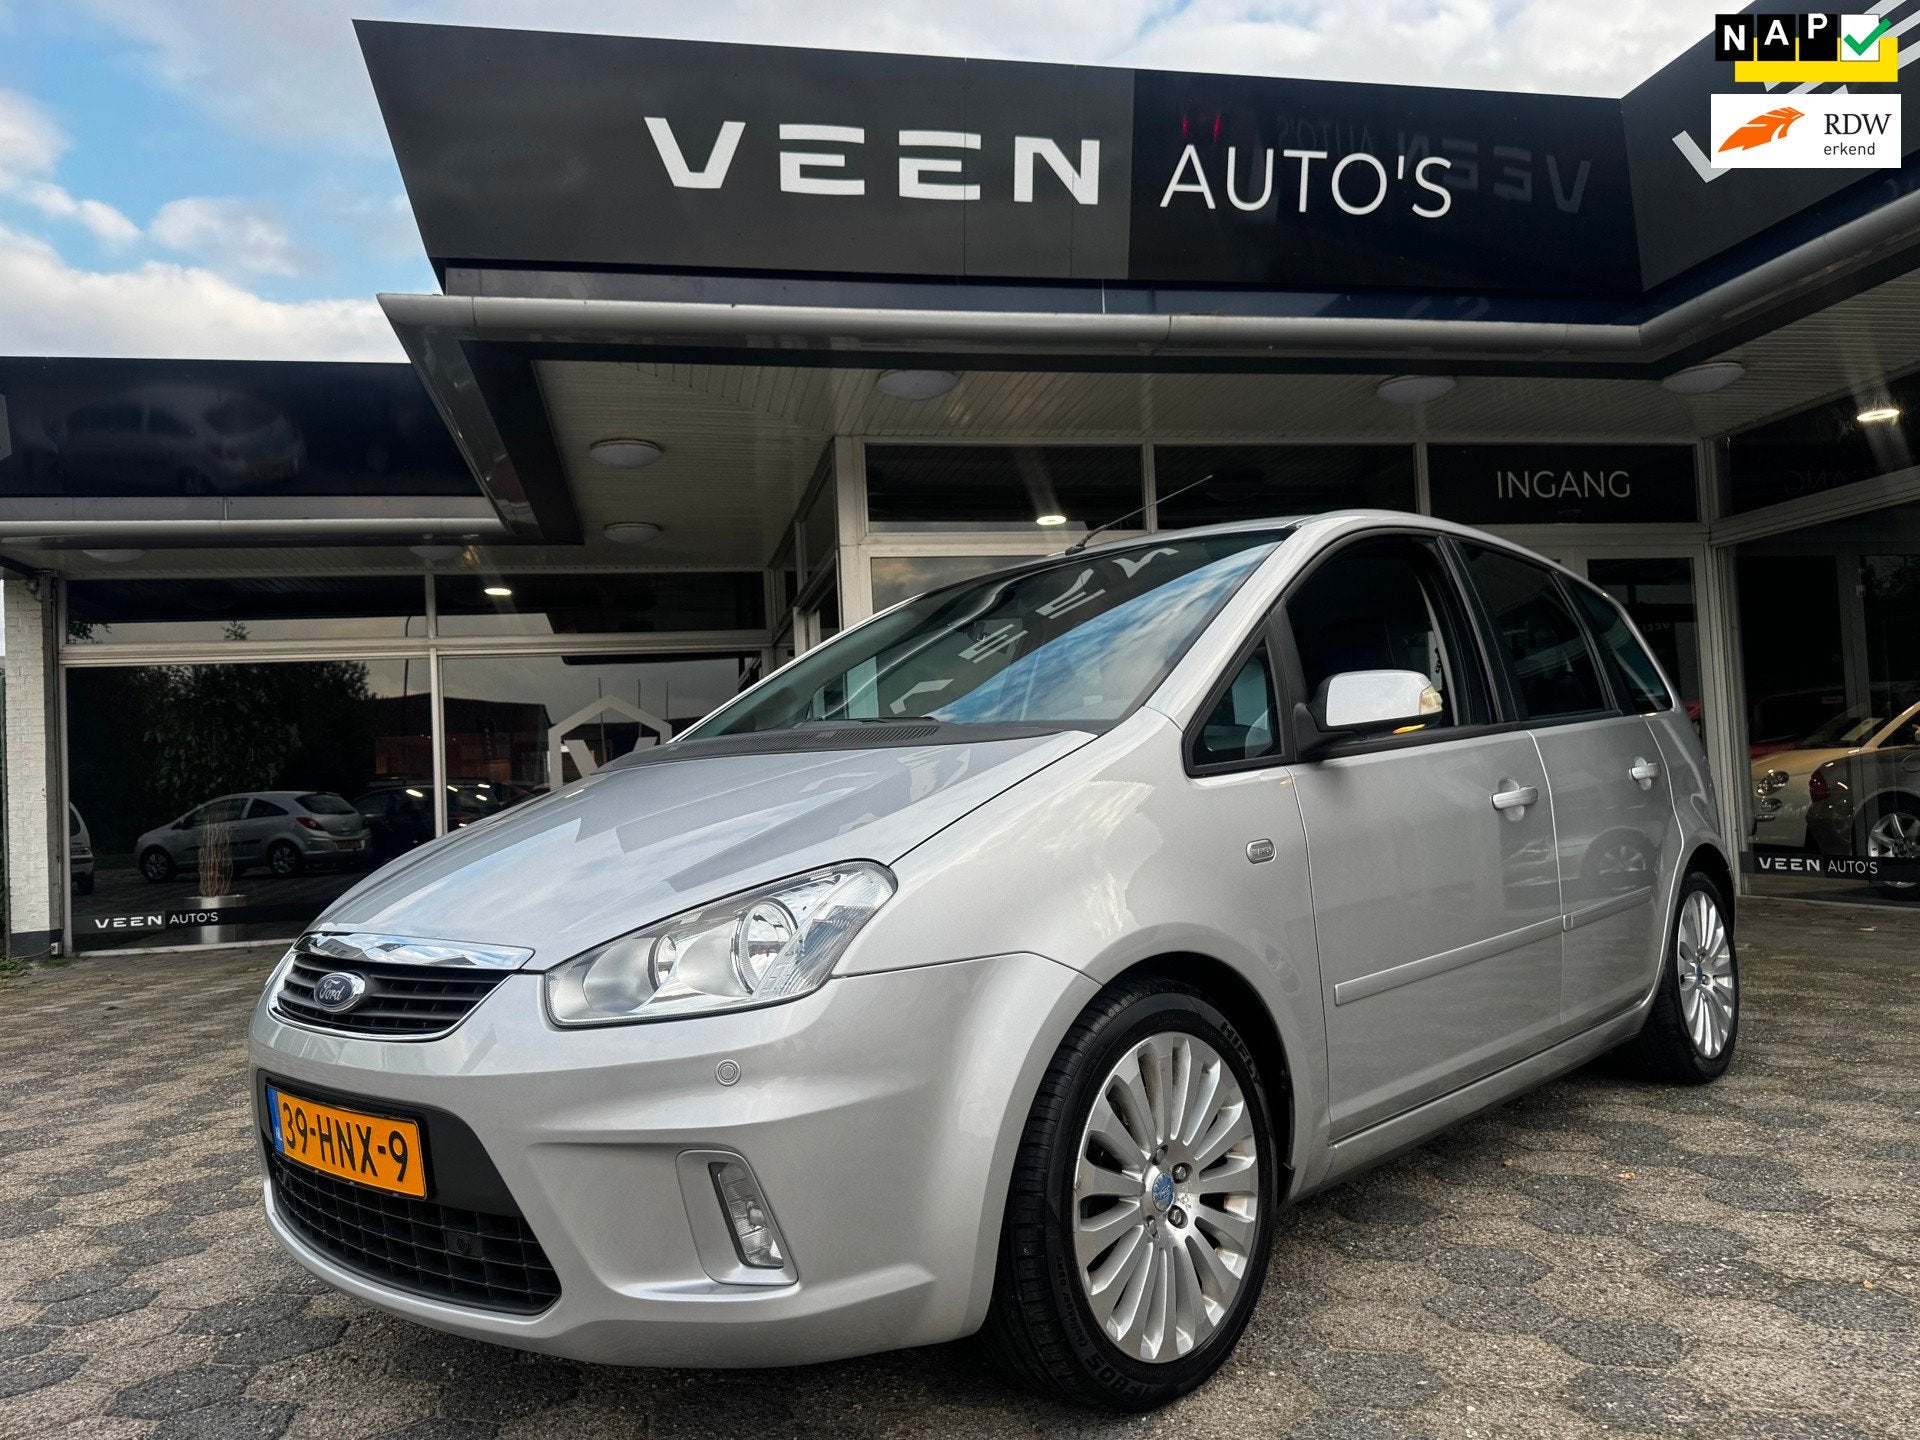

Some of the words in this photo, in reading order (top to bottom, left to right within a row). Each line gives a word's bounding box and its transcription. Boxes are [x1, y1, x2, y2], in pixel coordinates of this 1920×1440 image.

[644, 117, 1100, 205] VEEN
[1160, 144, 1452, 218] AUTO'S
[1497, 470, 1631, 498] INGANG
[1759, 856, 1821, 872] VEEN
[1828, 860, 1878, 874] AUTO'S
[94, 915, 162, 929] VEEN
[169, 911, 219, 925] AUTO'S
[319, 979, 346, 1001] Ford
[282, 1102, 409, 1183] 39-HNX-9
